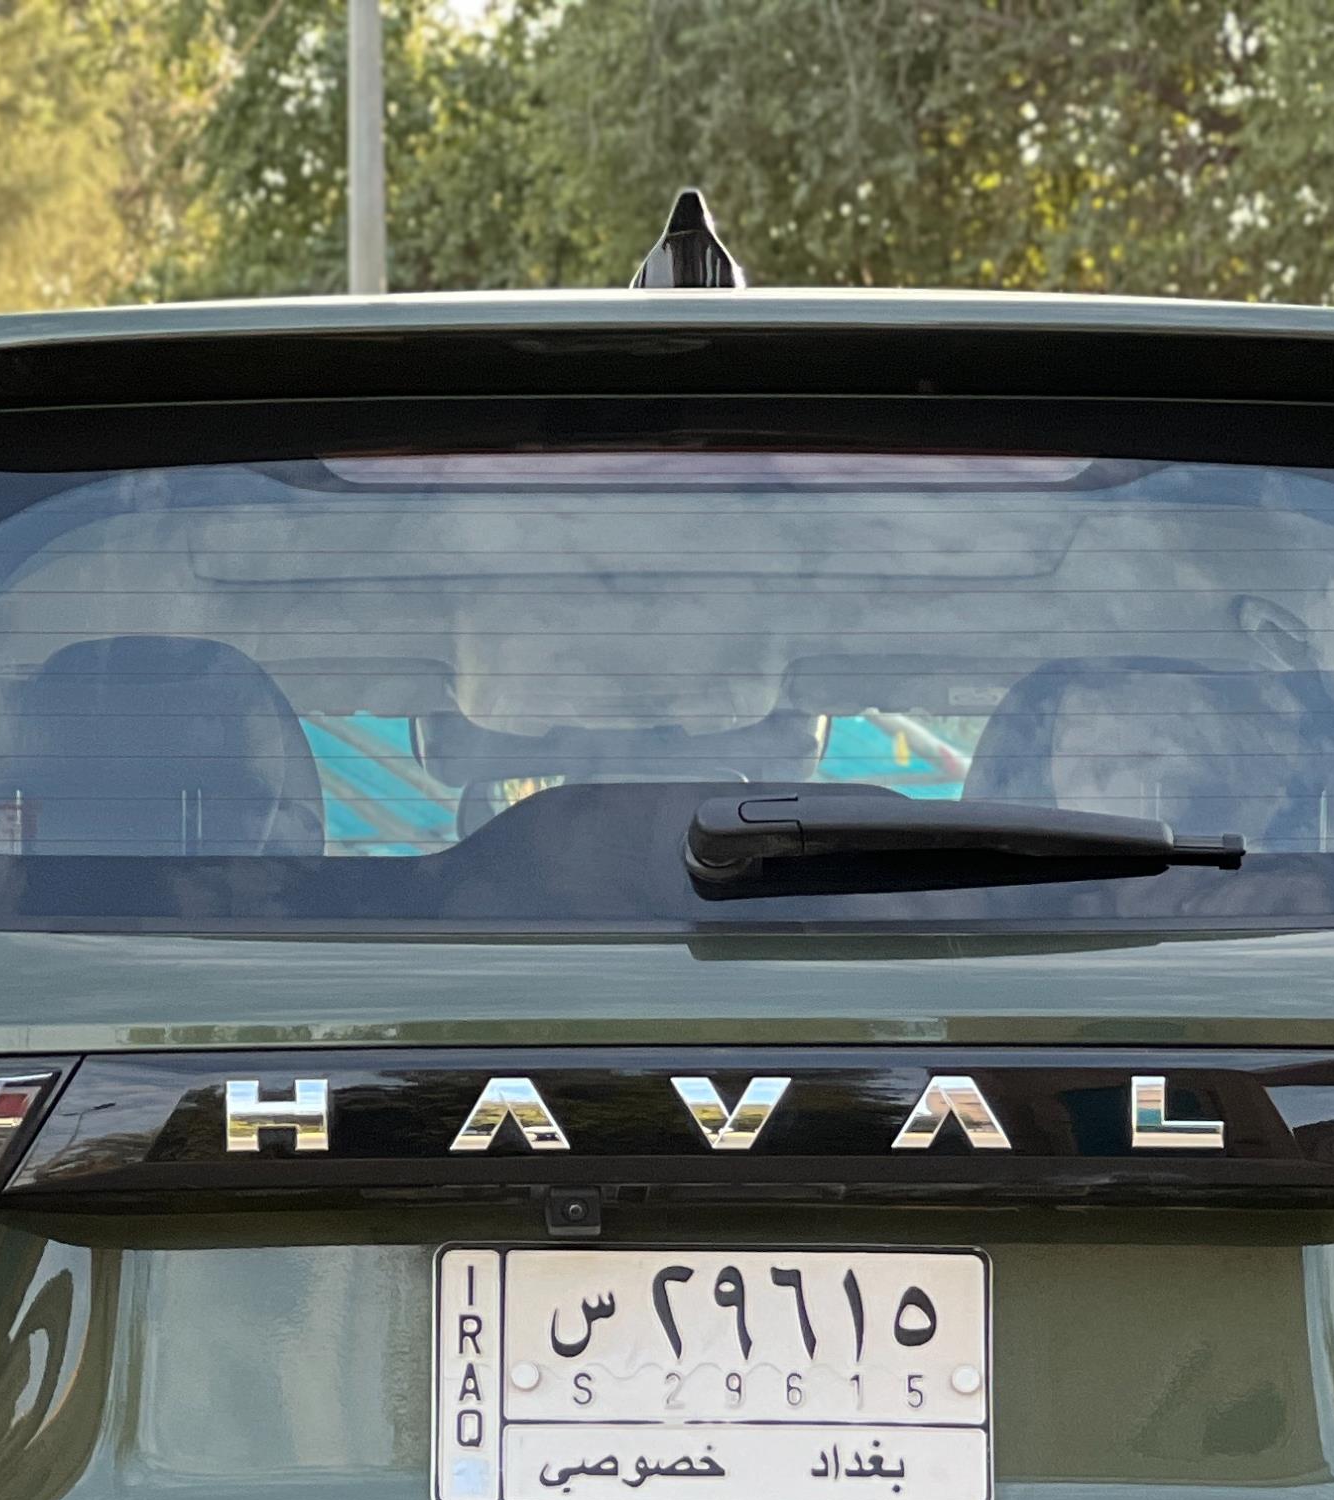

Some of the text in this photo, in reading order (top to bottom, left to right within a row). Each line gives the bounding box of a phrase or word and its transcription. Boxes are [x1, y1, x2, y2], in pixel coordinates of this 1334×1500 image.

[225, 1076, 1225, 1151] HAVAL
[456, 1265, 484, 1448] IRAQ
[539, 1440, 906, 1493] بغداد خصوصي
